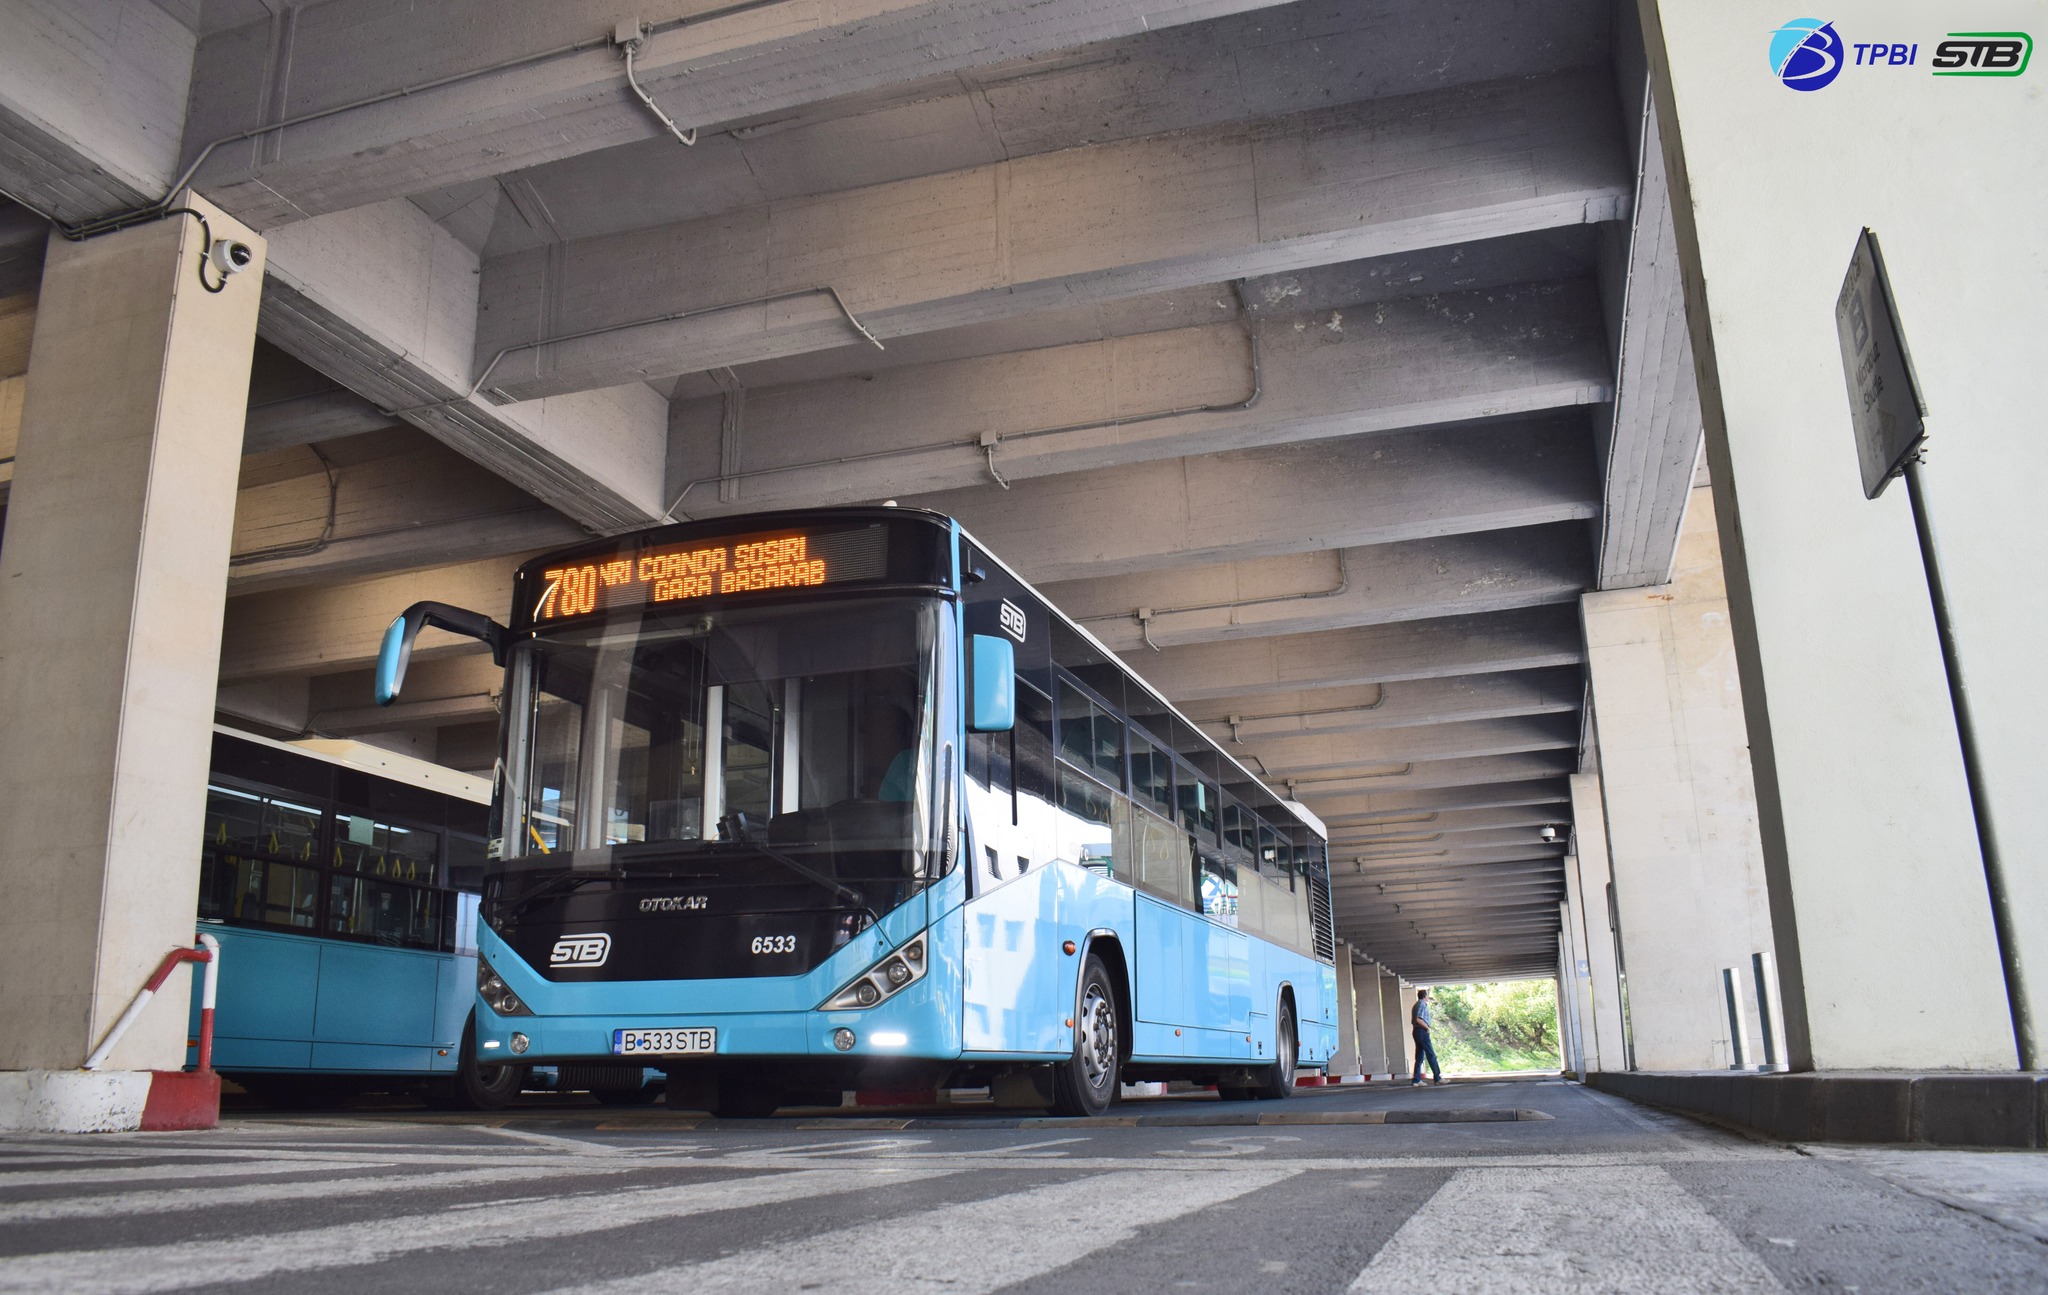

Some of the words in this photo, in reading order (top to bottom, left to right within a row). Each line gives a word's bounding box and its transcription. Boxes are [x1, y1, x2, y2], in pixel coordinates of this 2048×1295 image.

[1863, 373, 1884, 413] Shuttle
[638, 547, 727, 581] COANDA
[734, 536, 806, 569] SOSIRI
[545, 565, 597, 618] 780
[654, 574, 712, 602] GARA
[721, 560, 826, 593] BASARAB
[1000, 603, 1024, 635] STB
[638, 895, 709, 913] OTOKAR
[550, 938, 606, 963] STB
[751, 934, 797, 955] 6533
[675, 1031, 712, 1050] STB
